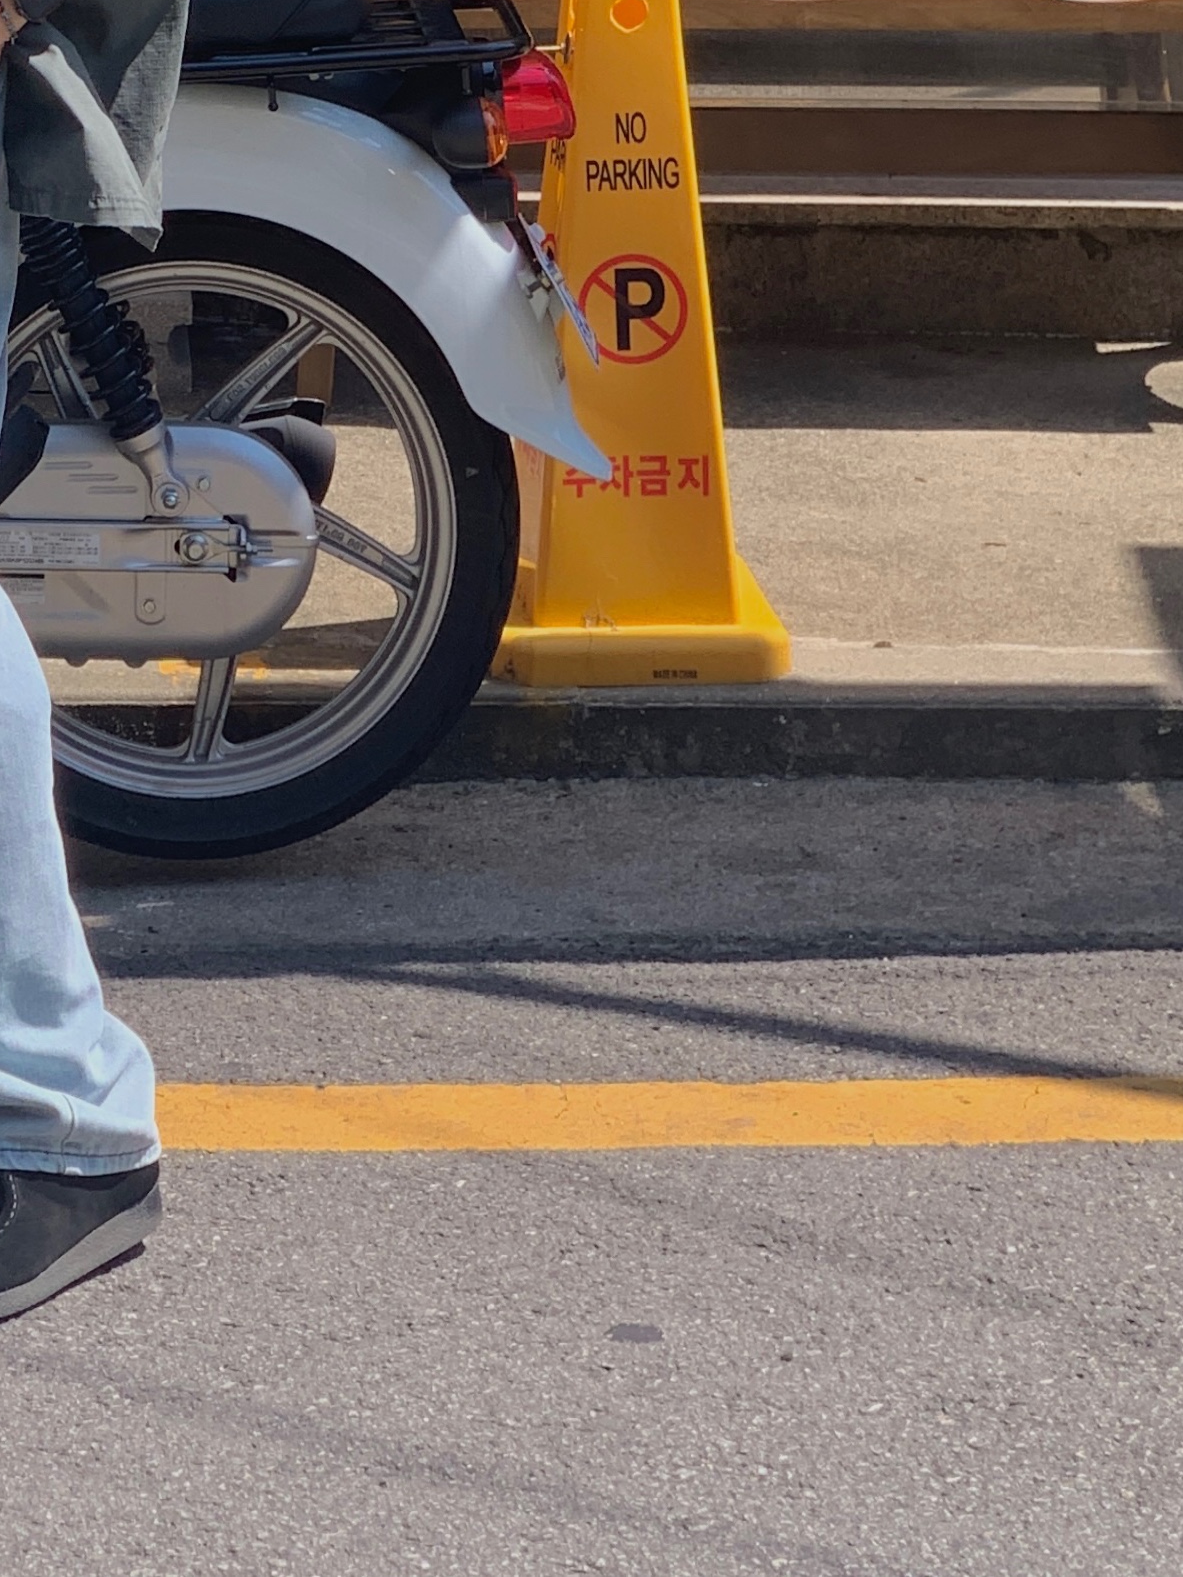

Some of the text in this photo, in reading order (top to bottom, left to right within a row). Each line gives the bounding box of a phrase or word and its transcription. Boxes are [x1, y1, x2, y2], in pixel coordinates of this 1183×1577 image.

[615, 112, 647, 144] NO
[585, 157, 681, 192] PARKING
[614, 268, 665, 351] P
